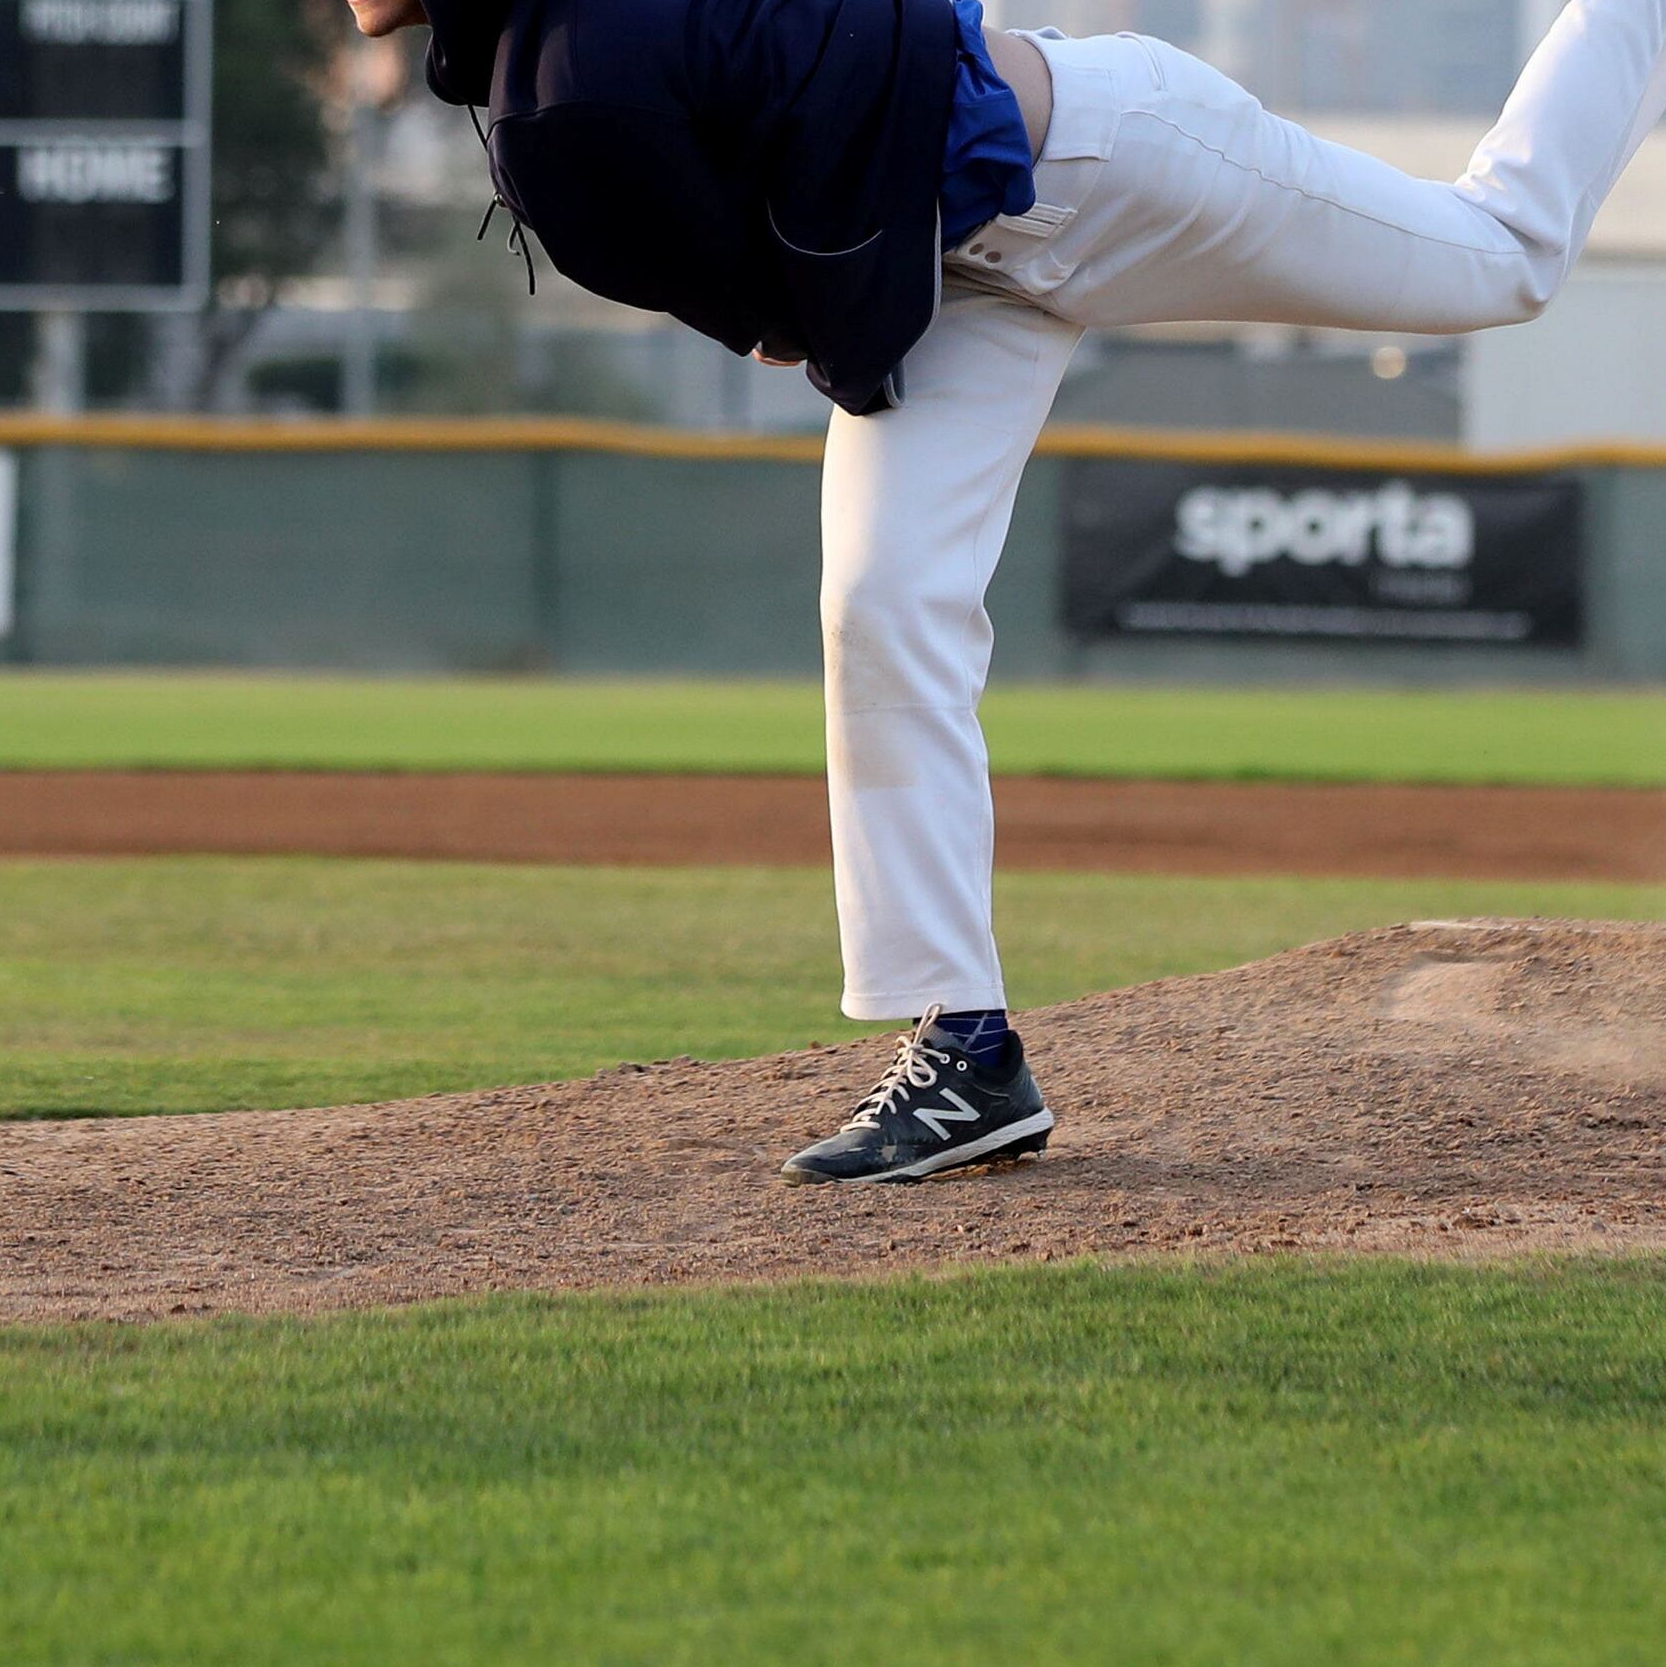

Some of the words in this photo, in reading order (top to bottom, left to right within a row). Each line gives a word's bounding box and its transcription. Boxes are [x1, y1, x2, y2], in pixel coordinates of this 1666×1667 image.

[21, 141, 170, 199] HOME
[1178, 483, 1472, 574] sporta
[913, 1086, 982, 1141] N
